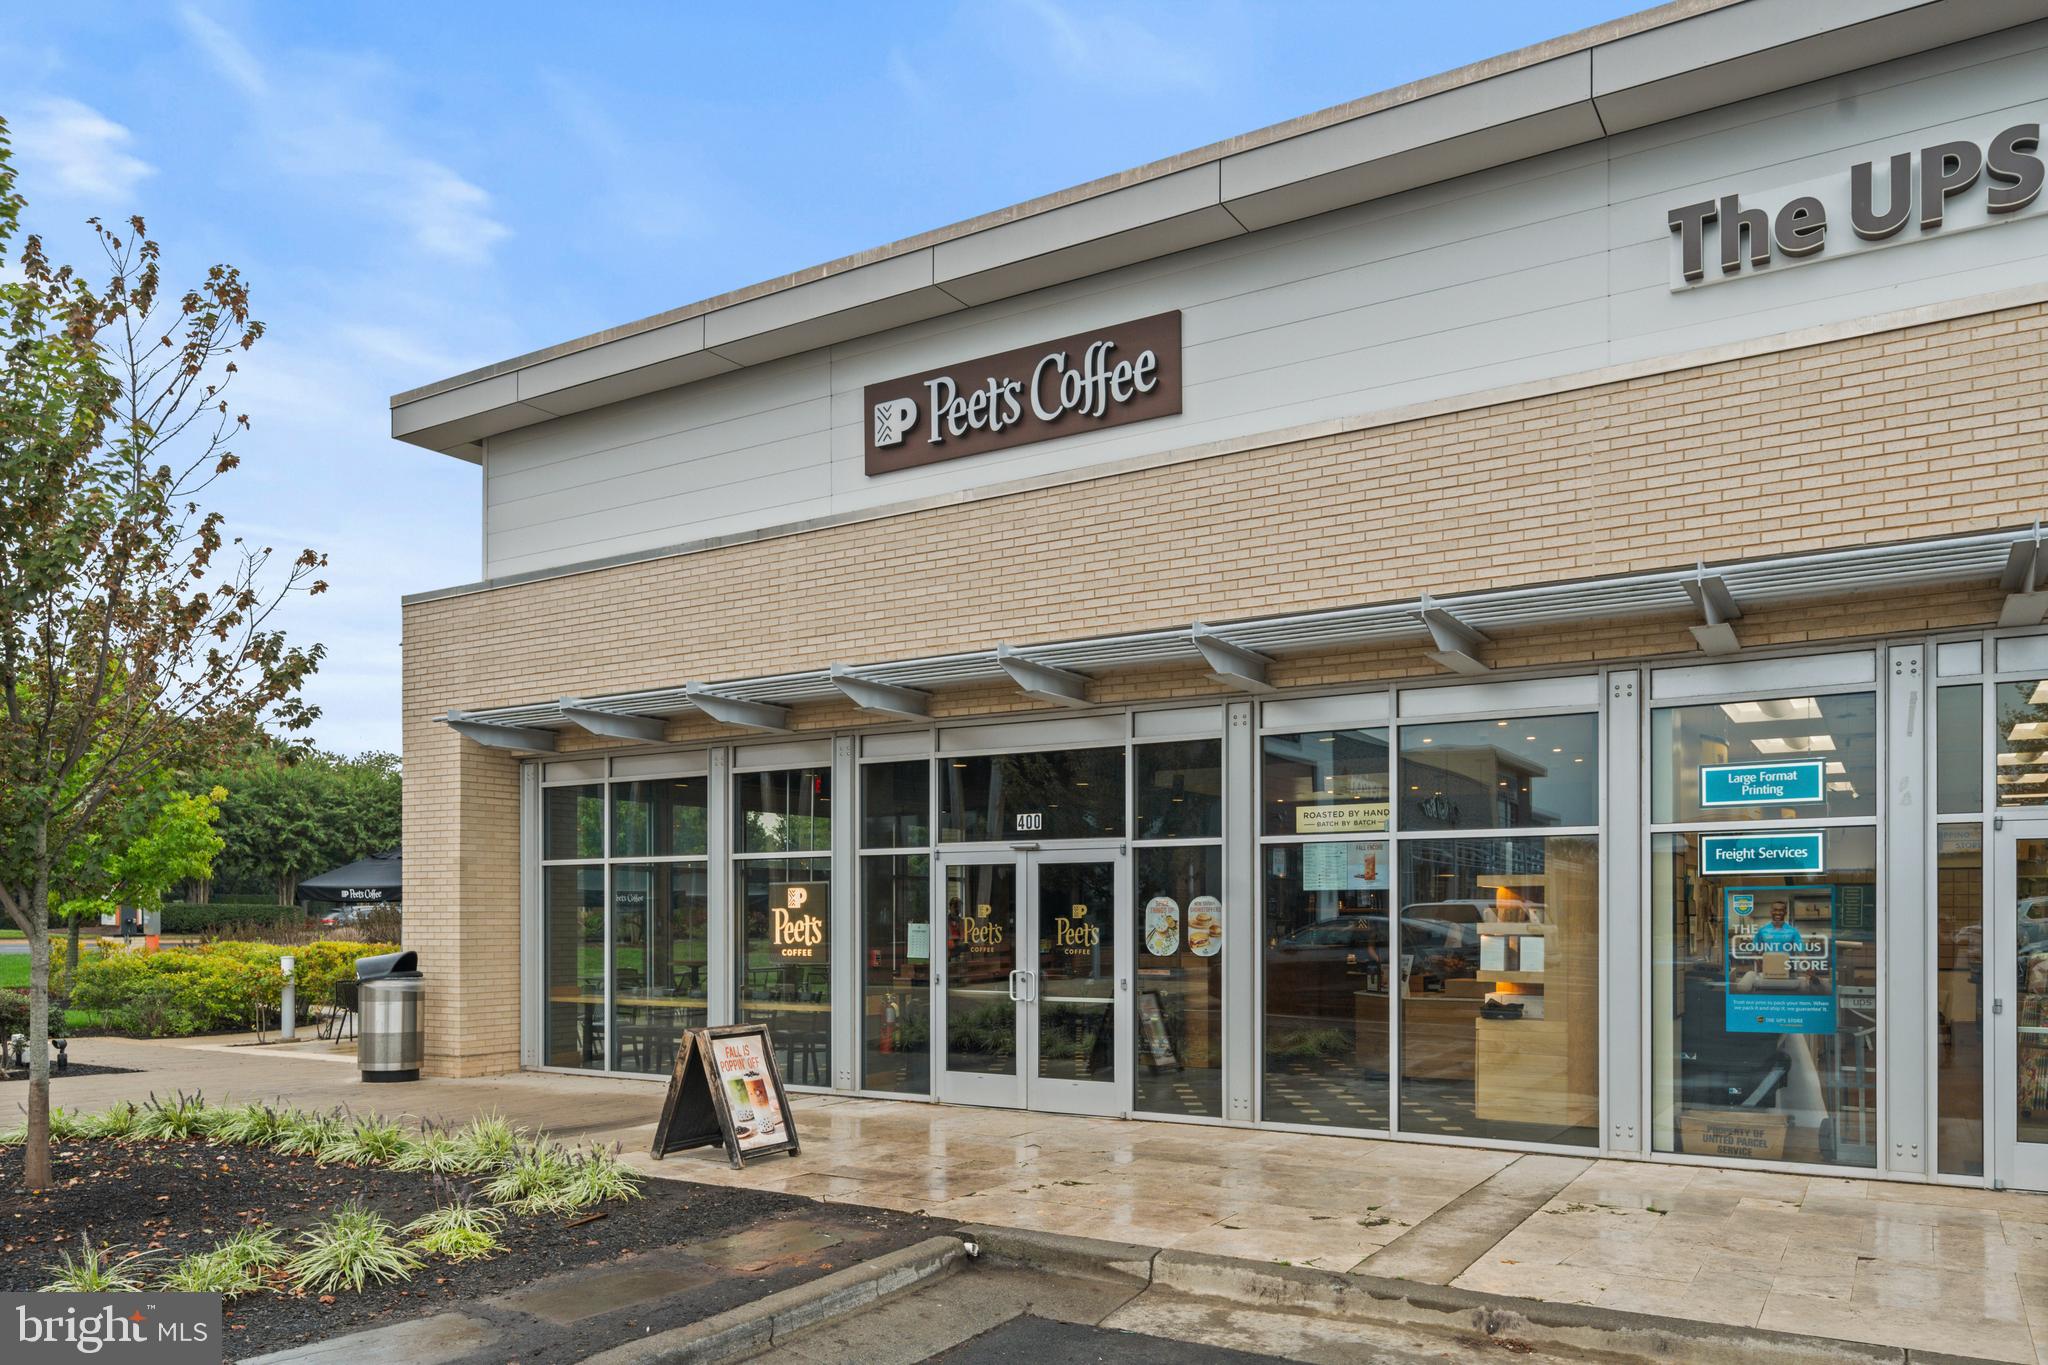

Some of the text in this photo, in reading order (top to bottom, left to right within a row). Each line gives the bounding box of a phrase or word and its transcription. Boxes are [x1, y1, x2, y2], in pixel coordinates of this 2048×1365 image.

[1668, 123, 2046, 281] The UPS
[923, 376, 1025, 444] Peet's
[1030, 340, 1157, 421] Coffee
[1728, 770, 1797, 785] Large Format
[1741, 784, 1784, 797] Printing
[1303, 810, 1345, 819] ROASTED
[1363, 808, 1390, 817] HAND
[1018, 814, 1041, 829] 400
[1715, 846, 1808, 862] Freight Services
[771, 907, 822, 946] Peet's
[962, 916, 1003, 945] Peet's
[1055, 917, 1100, 947] Peet's
[1733, 924, 1759, 935] THE
[781, 949, 813, 957] COFFEE
[1738, 942, 1822, 952] COUNT ON US
[1784, 960, 1829, 971] STORE
[725, 1044, 750, 1058] FALL IS
[748, 1056, 760, 1069] OFF
[1702, 1133, 1768, 1148] UNITED PARCEL
[1716, 1144, 1753, 1157] SERVICE
